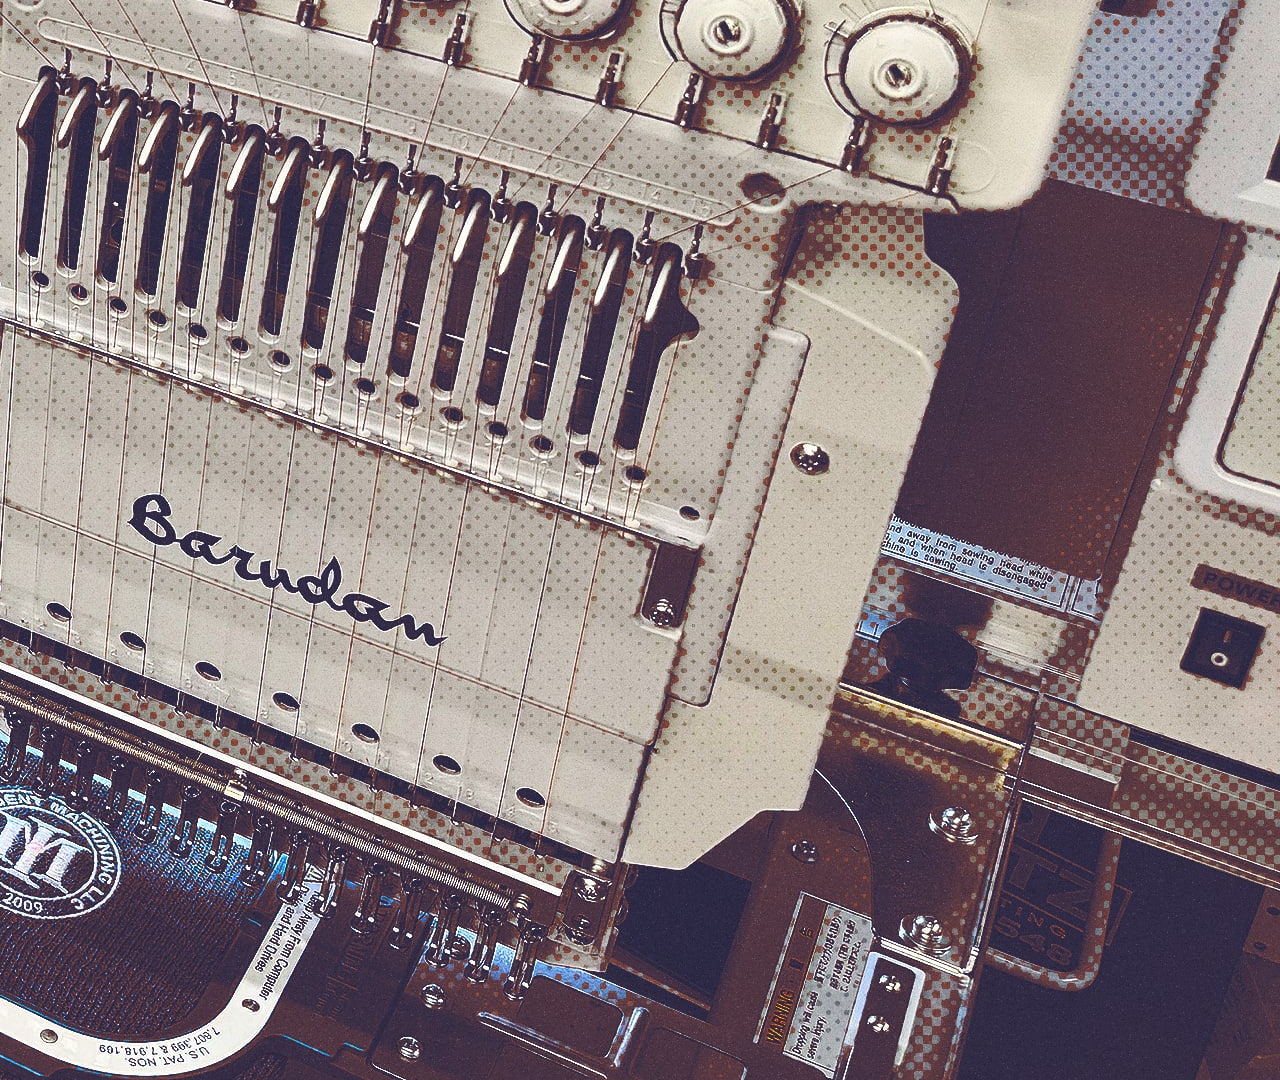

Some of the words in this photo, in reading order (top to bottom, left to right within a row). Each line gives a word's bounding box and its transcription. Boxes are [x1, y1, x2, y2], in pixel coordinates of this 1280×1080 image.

[897, 536, 917, 549] and
[920, 542, 945, 557] when
[950, 551, 974, 566] head
[906, 529, 932, 545] away
[936, 536, 957, 551] from
[962, 546, 995, 565] sewing
[1000, 557, 1024, 573] head
[127, 493, 448, 647] Barudan
[49, 800, 115, 885] MACHINING
[2, 892, 44, 913] 2009
[70, 885, 105, 910] LLC
[280, 906, 295, 927] and
[290, 911, 313, 937] Away
[268, 924, 287, 948] Hard
[281, 933, 302, 958] From
[254, 945, 278, 973] Drives
[258, 955, 289, 1001] Computer
[766, 989, 795, 1045] WARNING
[791, 1025, 811, 1055] Dropping
[124, 1057, 157, 1067] NOS.
[159, 1053, 185, 1066] PAT.
